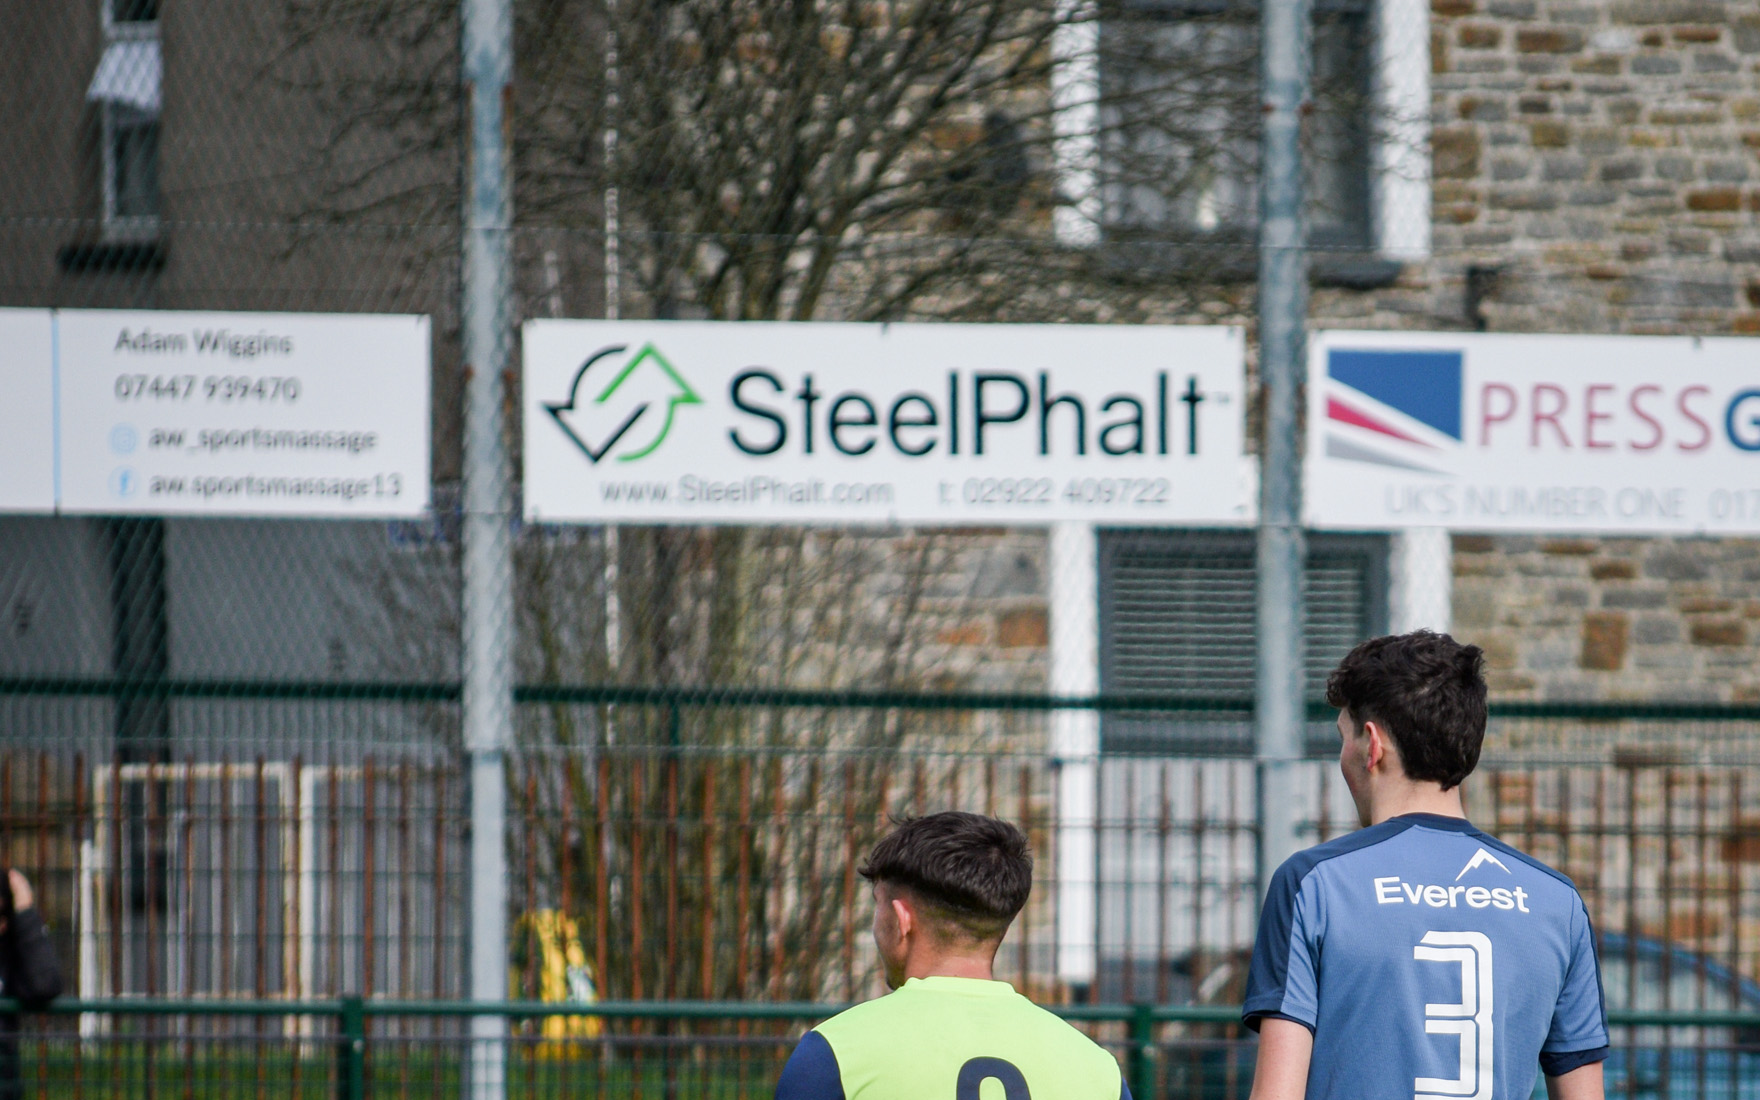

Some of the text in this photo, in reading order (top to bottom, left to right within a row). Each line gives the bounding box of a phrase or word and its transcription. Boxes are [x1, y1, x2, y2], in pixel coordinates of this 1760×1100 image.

[115, 329, 187, 353] Adam
[114, 375, 195, 400] 07447
[728, 370, 1202, 455] SteelPhalt
[600, 475, 894, 503] www.SteelPhalt.com
[962, 477, 1052, 504] 02922
[1616, 487, 1686, 518] ONE
[1374, 876, 1529, 913] Everest
